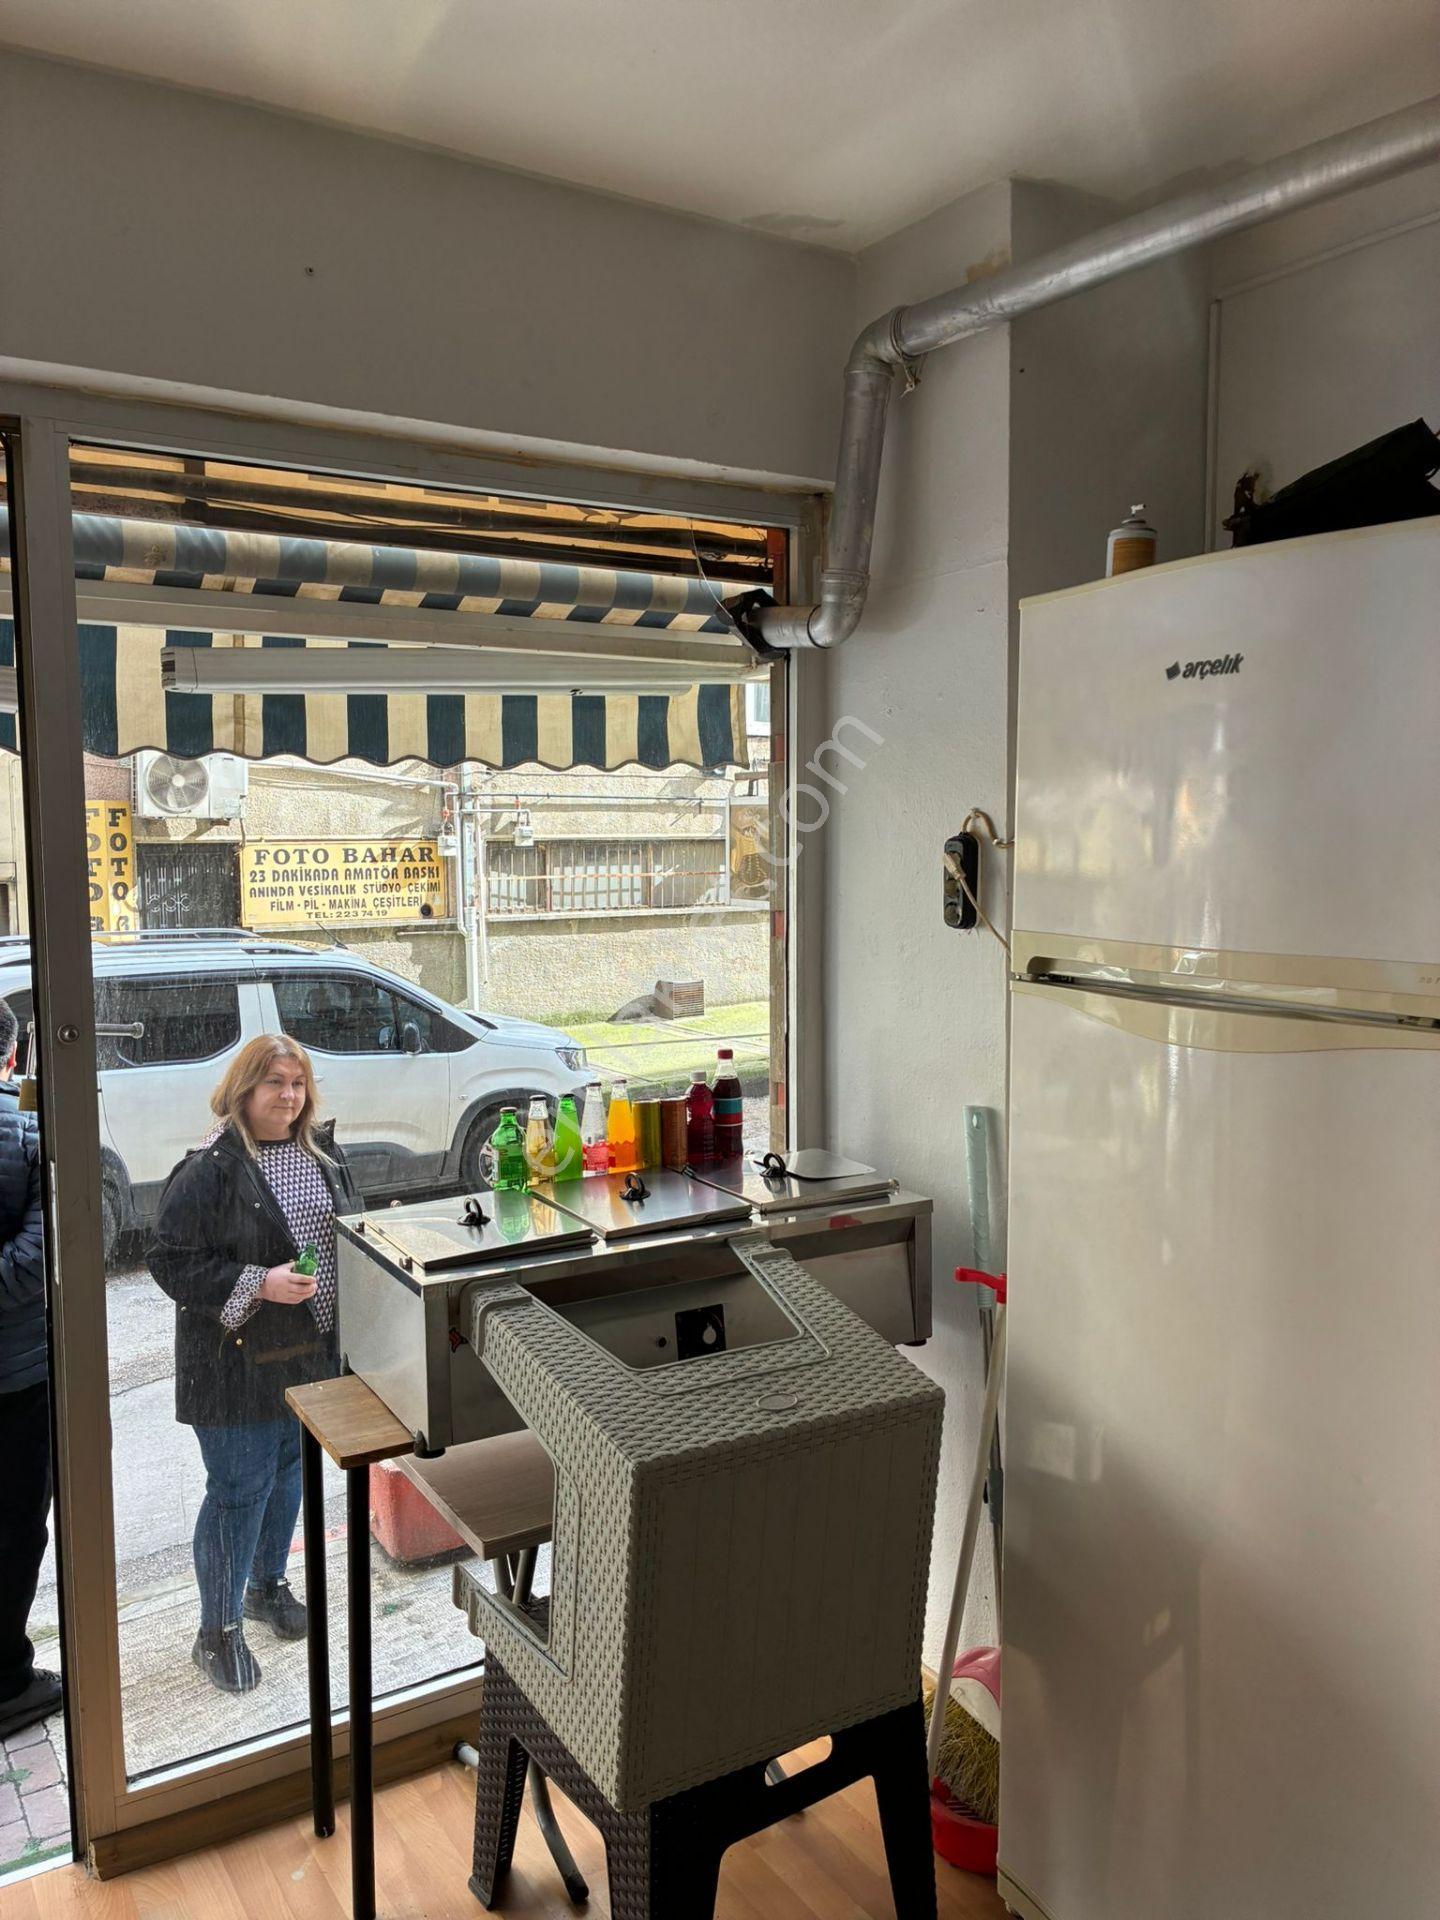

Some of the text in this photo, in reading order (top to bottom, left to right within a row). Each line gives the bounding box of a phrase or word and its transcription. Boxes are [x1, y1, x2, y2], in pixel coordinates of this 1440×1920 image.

[108, 808, 129, 901] FOTO
[254, 847, 434, 866] FOTO BAHAR
[249, 865, 440, 883] 23 DAKİKADA AMATÖR BASKI
[249, 886, 295, 898] ANINDA
[299, 883, 356, 896] VESİKALIK
[363, 881, 402, 894] STÜDYO
[270, 899, 295, 911] FİLM
[304, 898, 319, 910] PİL
